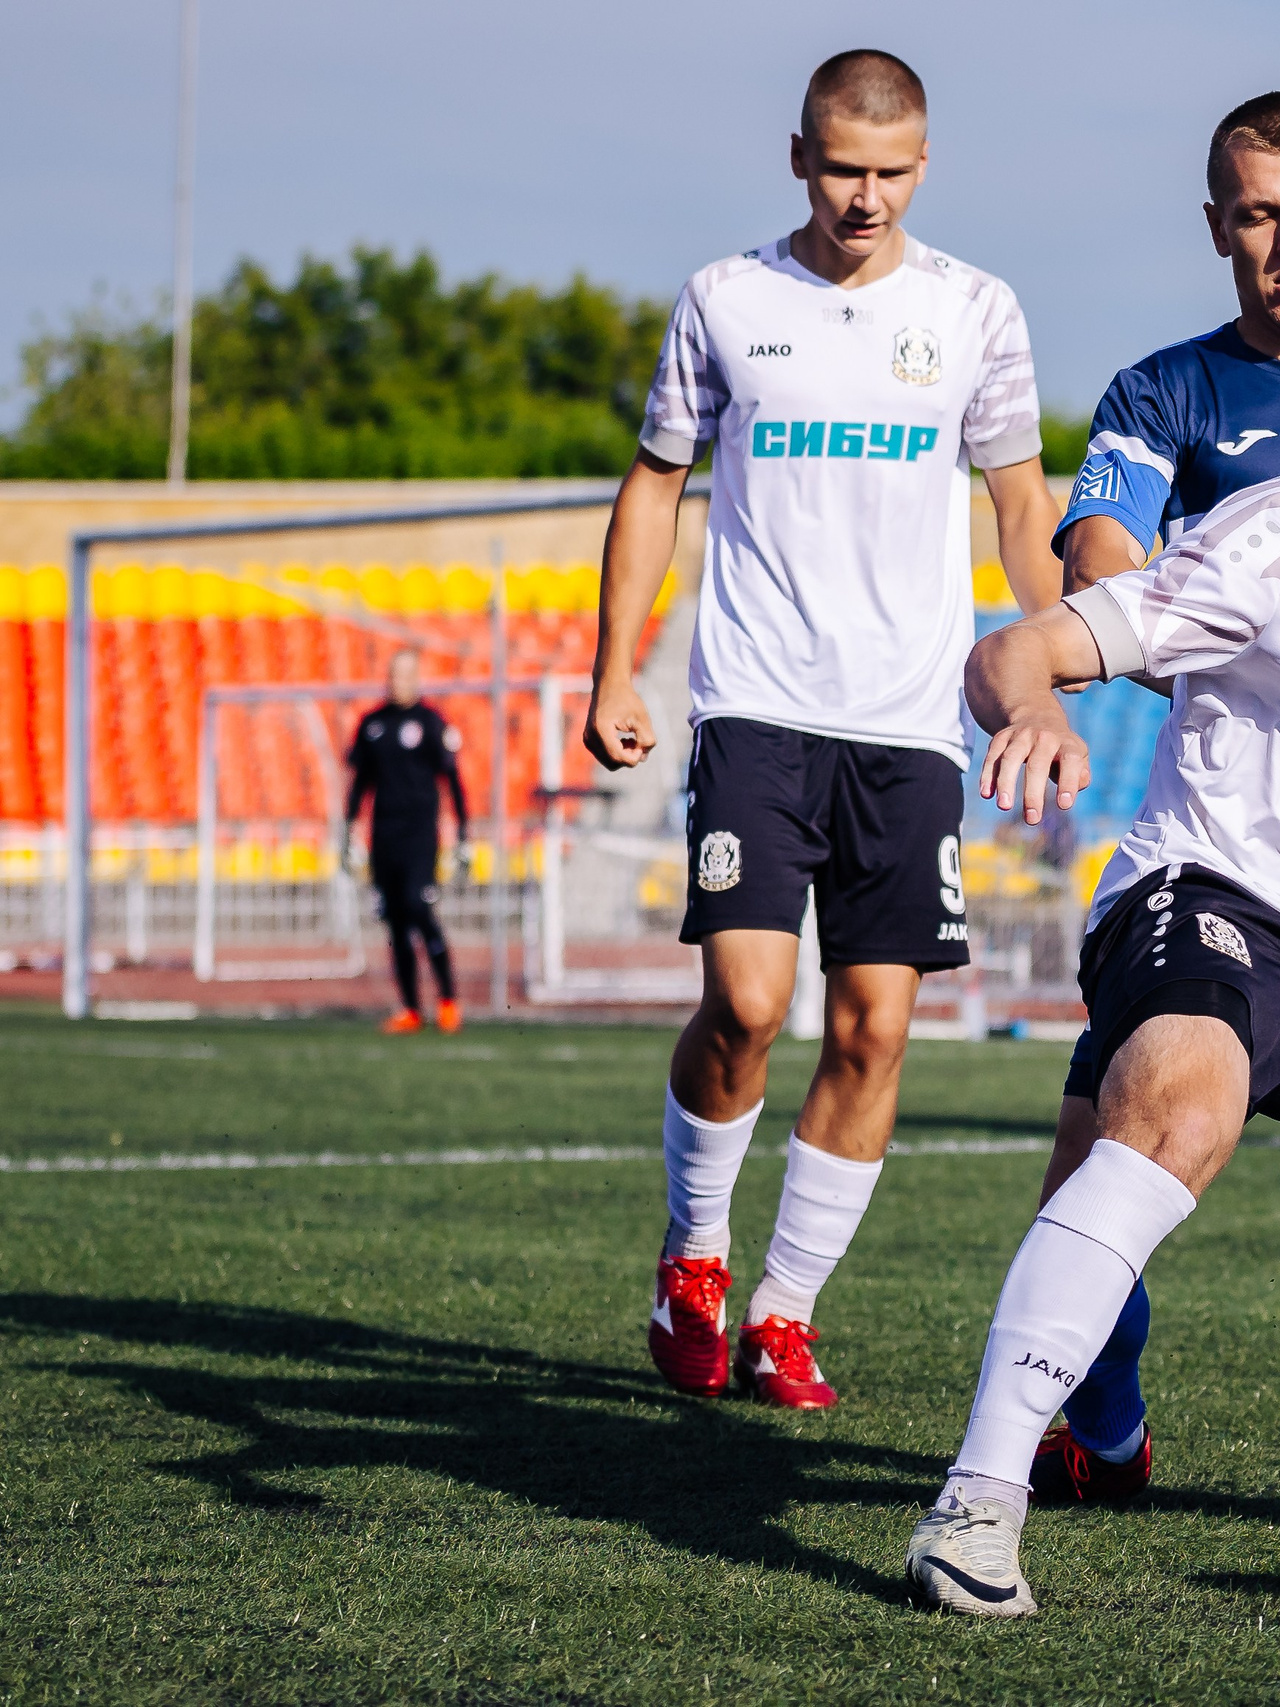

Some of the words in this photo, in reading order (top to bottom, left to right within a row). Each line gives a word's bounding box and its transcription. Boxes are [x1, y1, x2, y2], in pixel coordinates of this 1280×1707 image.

[747, 344, 792, 357] JAKO
[752, 421, 939, 462] СИБУР
[938, 835, 967, 915] 9
[937, 922, 969, 941] JAK
[1012, 1352, 1076, 1388] JAKO
